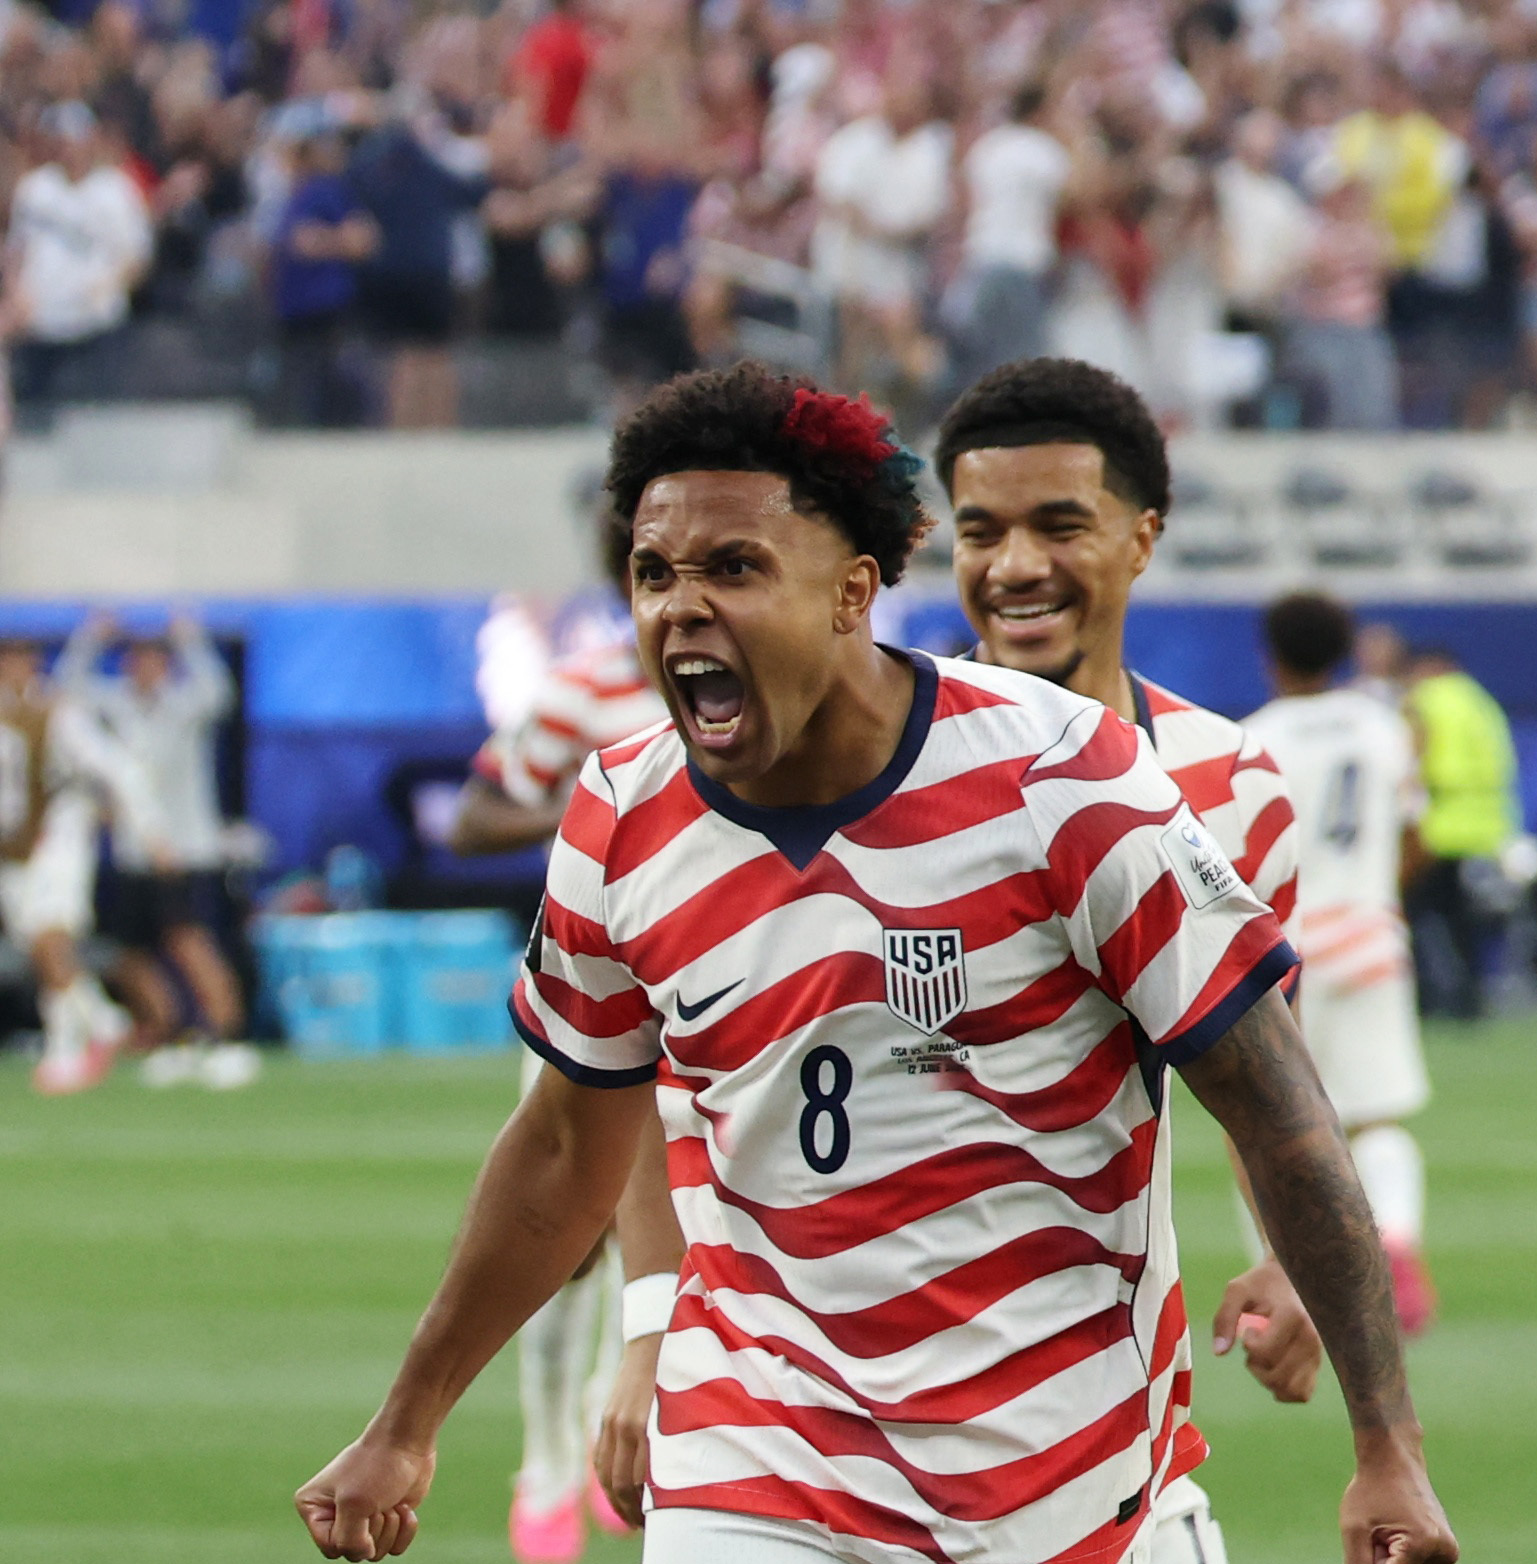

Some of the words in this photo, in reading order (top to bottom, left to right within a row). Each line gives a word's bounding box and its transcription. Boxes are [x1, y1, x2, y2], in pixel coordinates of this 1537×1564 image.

[889, 934, 957, 975] USA
[891, 1046, 907, 1056] USA
[799, 1044, 853, 1174] 8
